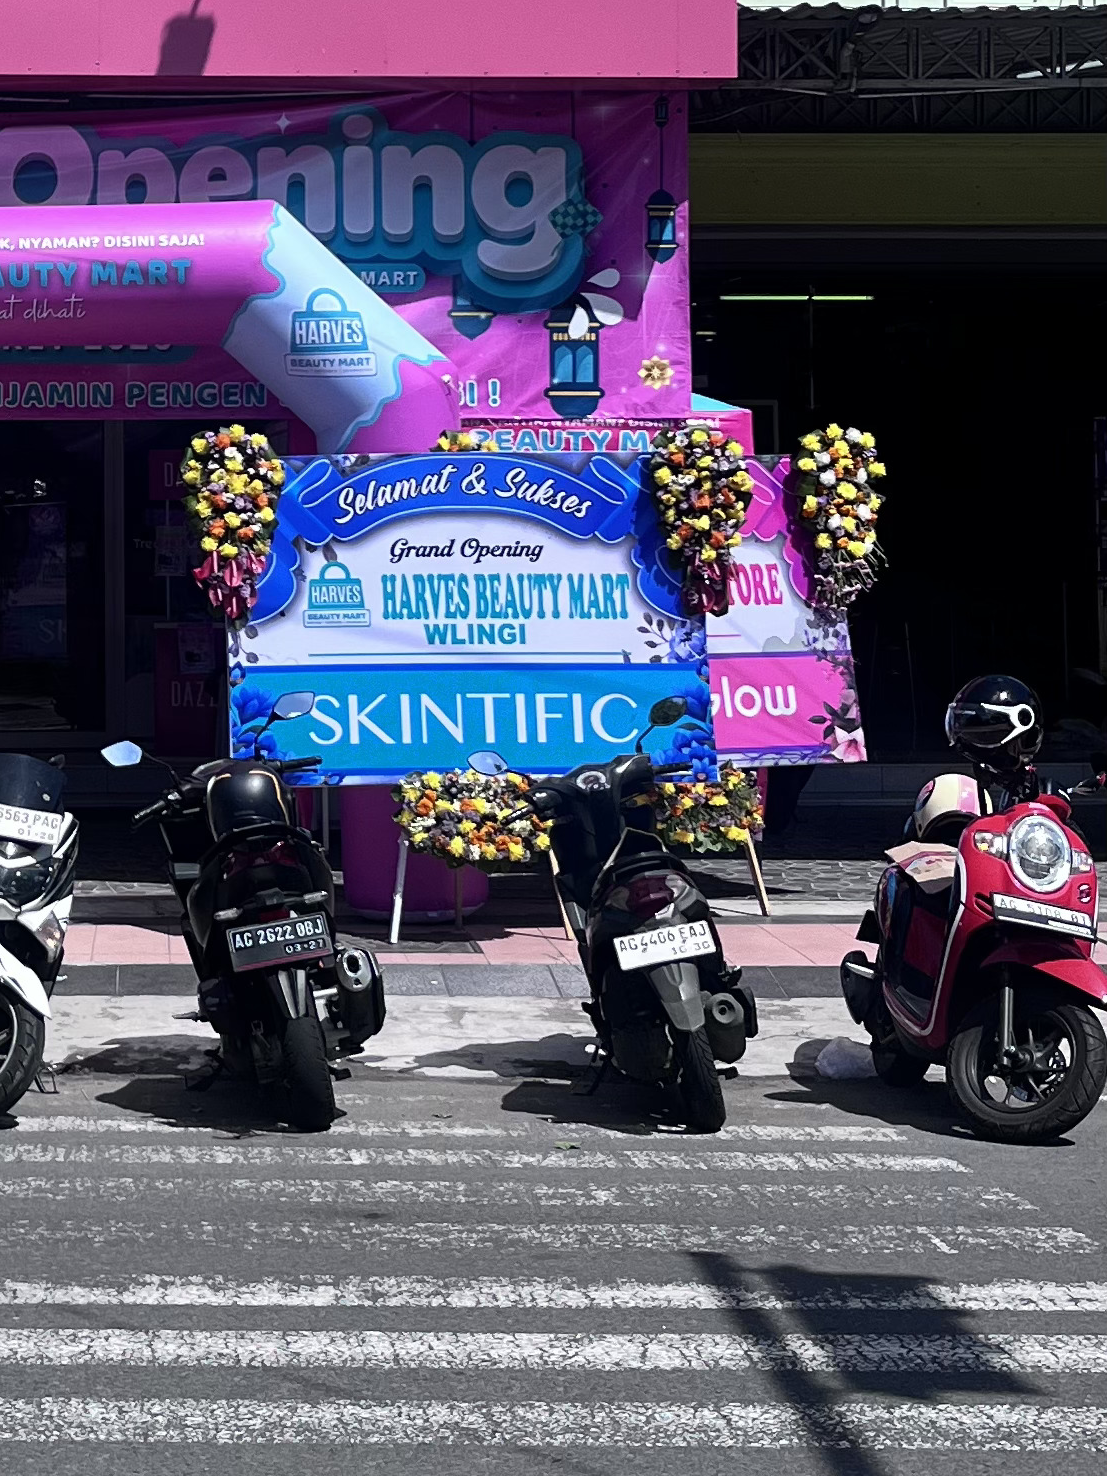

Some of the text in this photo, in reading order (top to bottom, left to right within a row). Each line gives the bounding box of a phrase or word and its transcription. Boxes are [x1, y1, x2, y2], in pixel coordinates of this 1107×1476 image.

[18, 236, 100, 250] NYAMAN?
[104, 235, 155, 248] DISINI
[158, 233, 205, 247] SAJA!
[90, 259, 191, 286] MART
[360, 271, 418, 285] MART
[23, 293, 86, 323] dihati
[294, 319, 363, 344] HARVES
[290, 357, 371, 368] BEAUTY MART
[125, 380, 268, 408] PENGEN
[335, 462, 593, 523] Selamat & Sukses
[390, 539, 543, 565] Grand Opening
[311, 586, 361, 603] HARVES
[381, 573, 629, 620] HARVES BEAUTY MART
[727, 563, 783, 606] ORE
[424, 623, 527, 645] WLINGI
[309, 692, 640, 746] SKINTIFIC
[33, 813, 59, 830] PAG
[1000, 898, 1017, 909] AG
[235, 919, 323, 949] AG 2622 OBJ
[619, 923, 707, 952] AG 4406 EAJ
